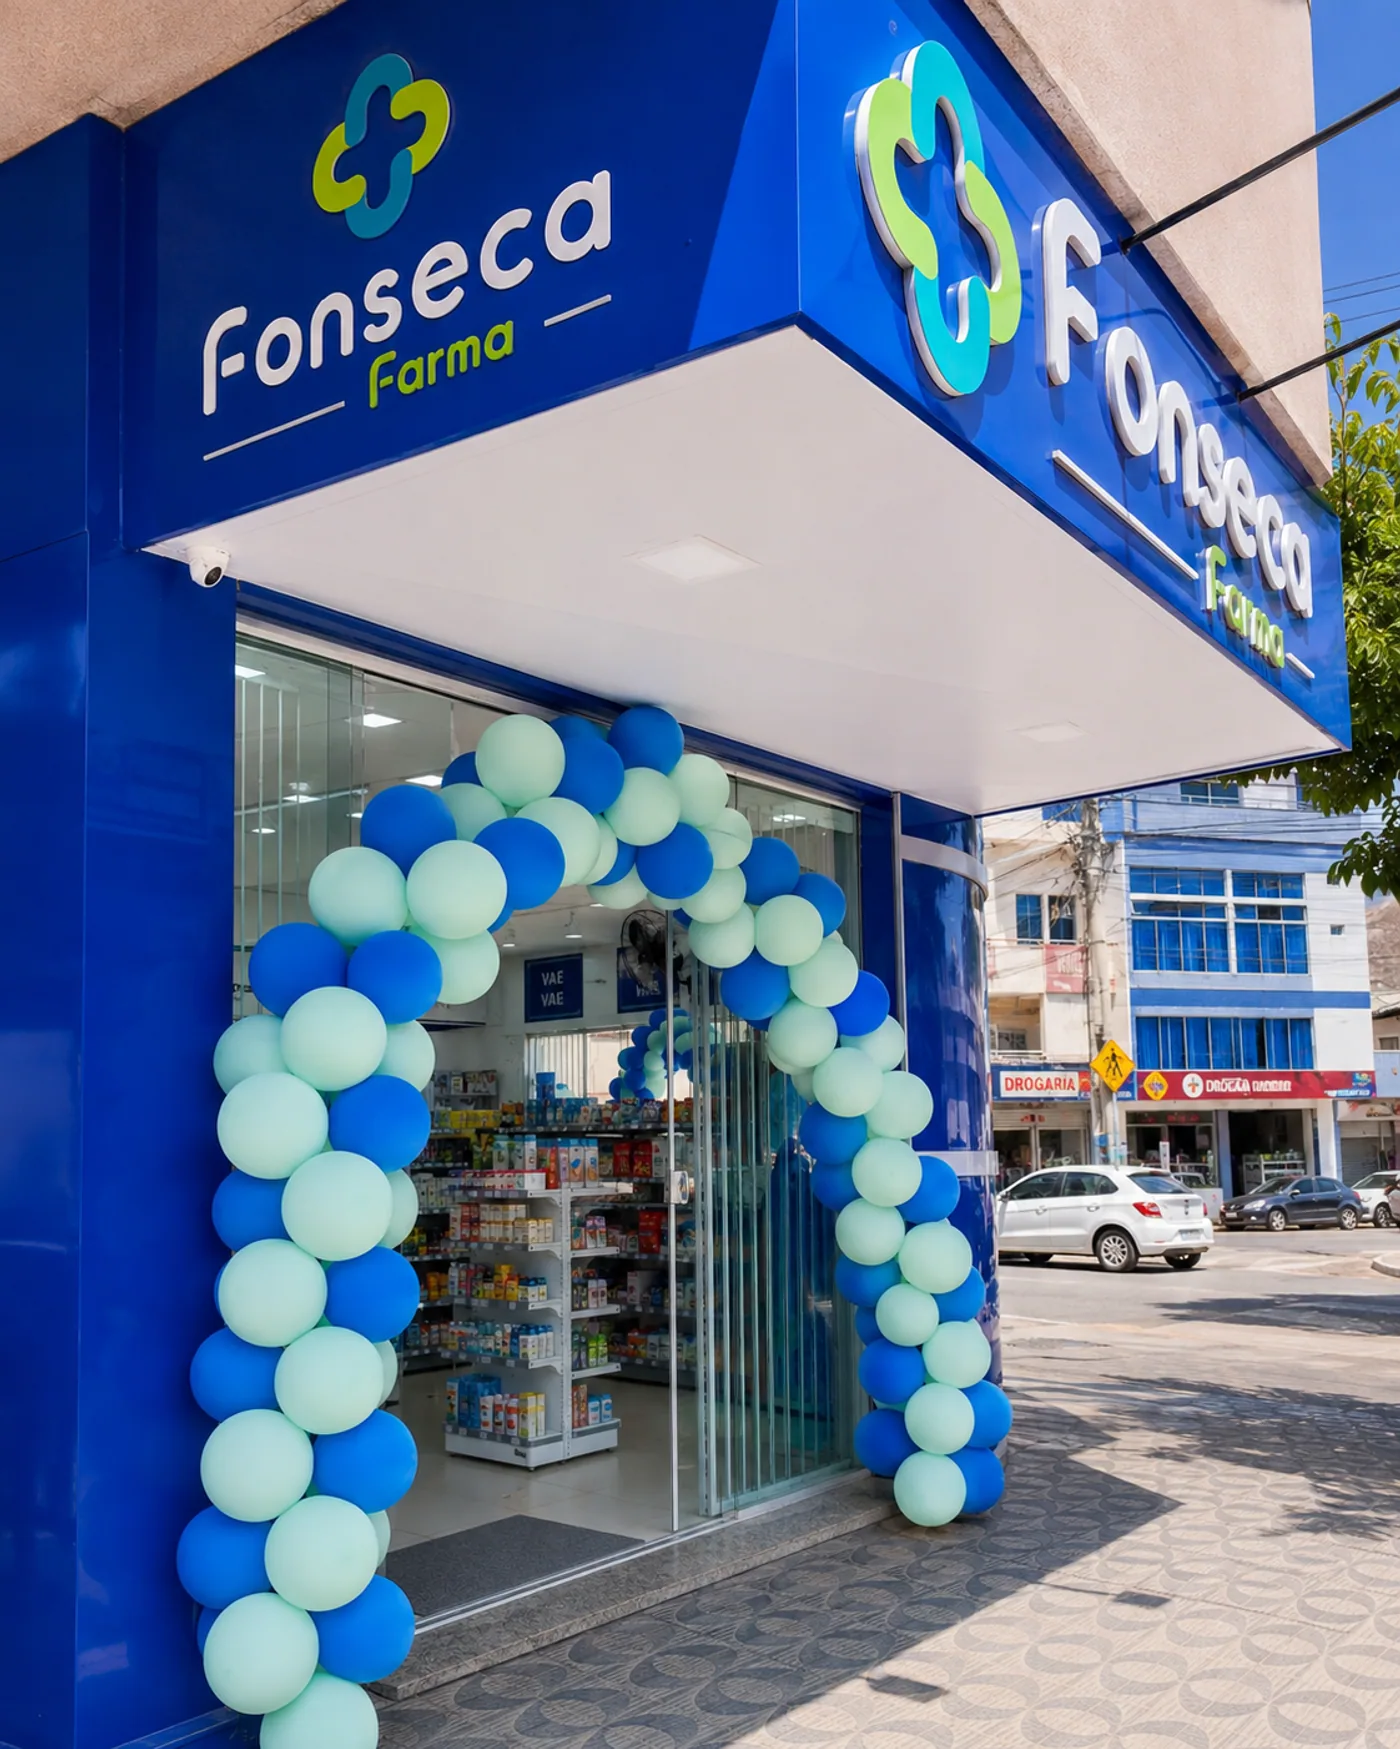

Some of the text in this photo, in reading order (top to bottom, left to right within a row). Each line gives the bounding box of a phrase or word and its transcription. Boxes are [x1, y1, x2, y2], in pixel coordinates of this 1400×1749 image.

[203, 169, 612, 416] Fonseca
[369, 320, 515, 409] Farma
[1040, 197, 1314, 619] Fonseca
[1204, 544, 1285, 669] Farma
[1004, 1076, 1076, 1091] DROGARIA
